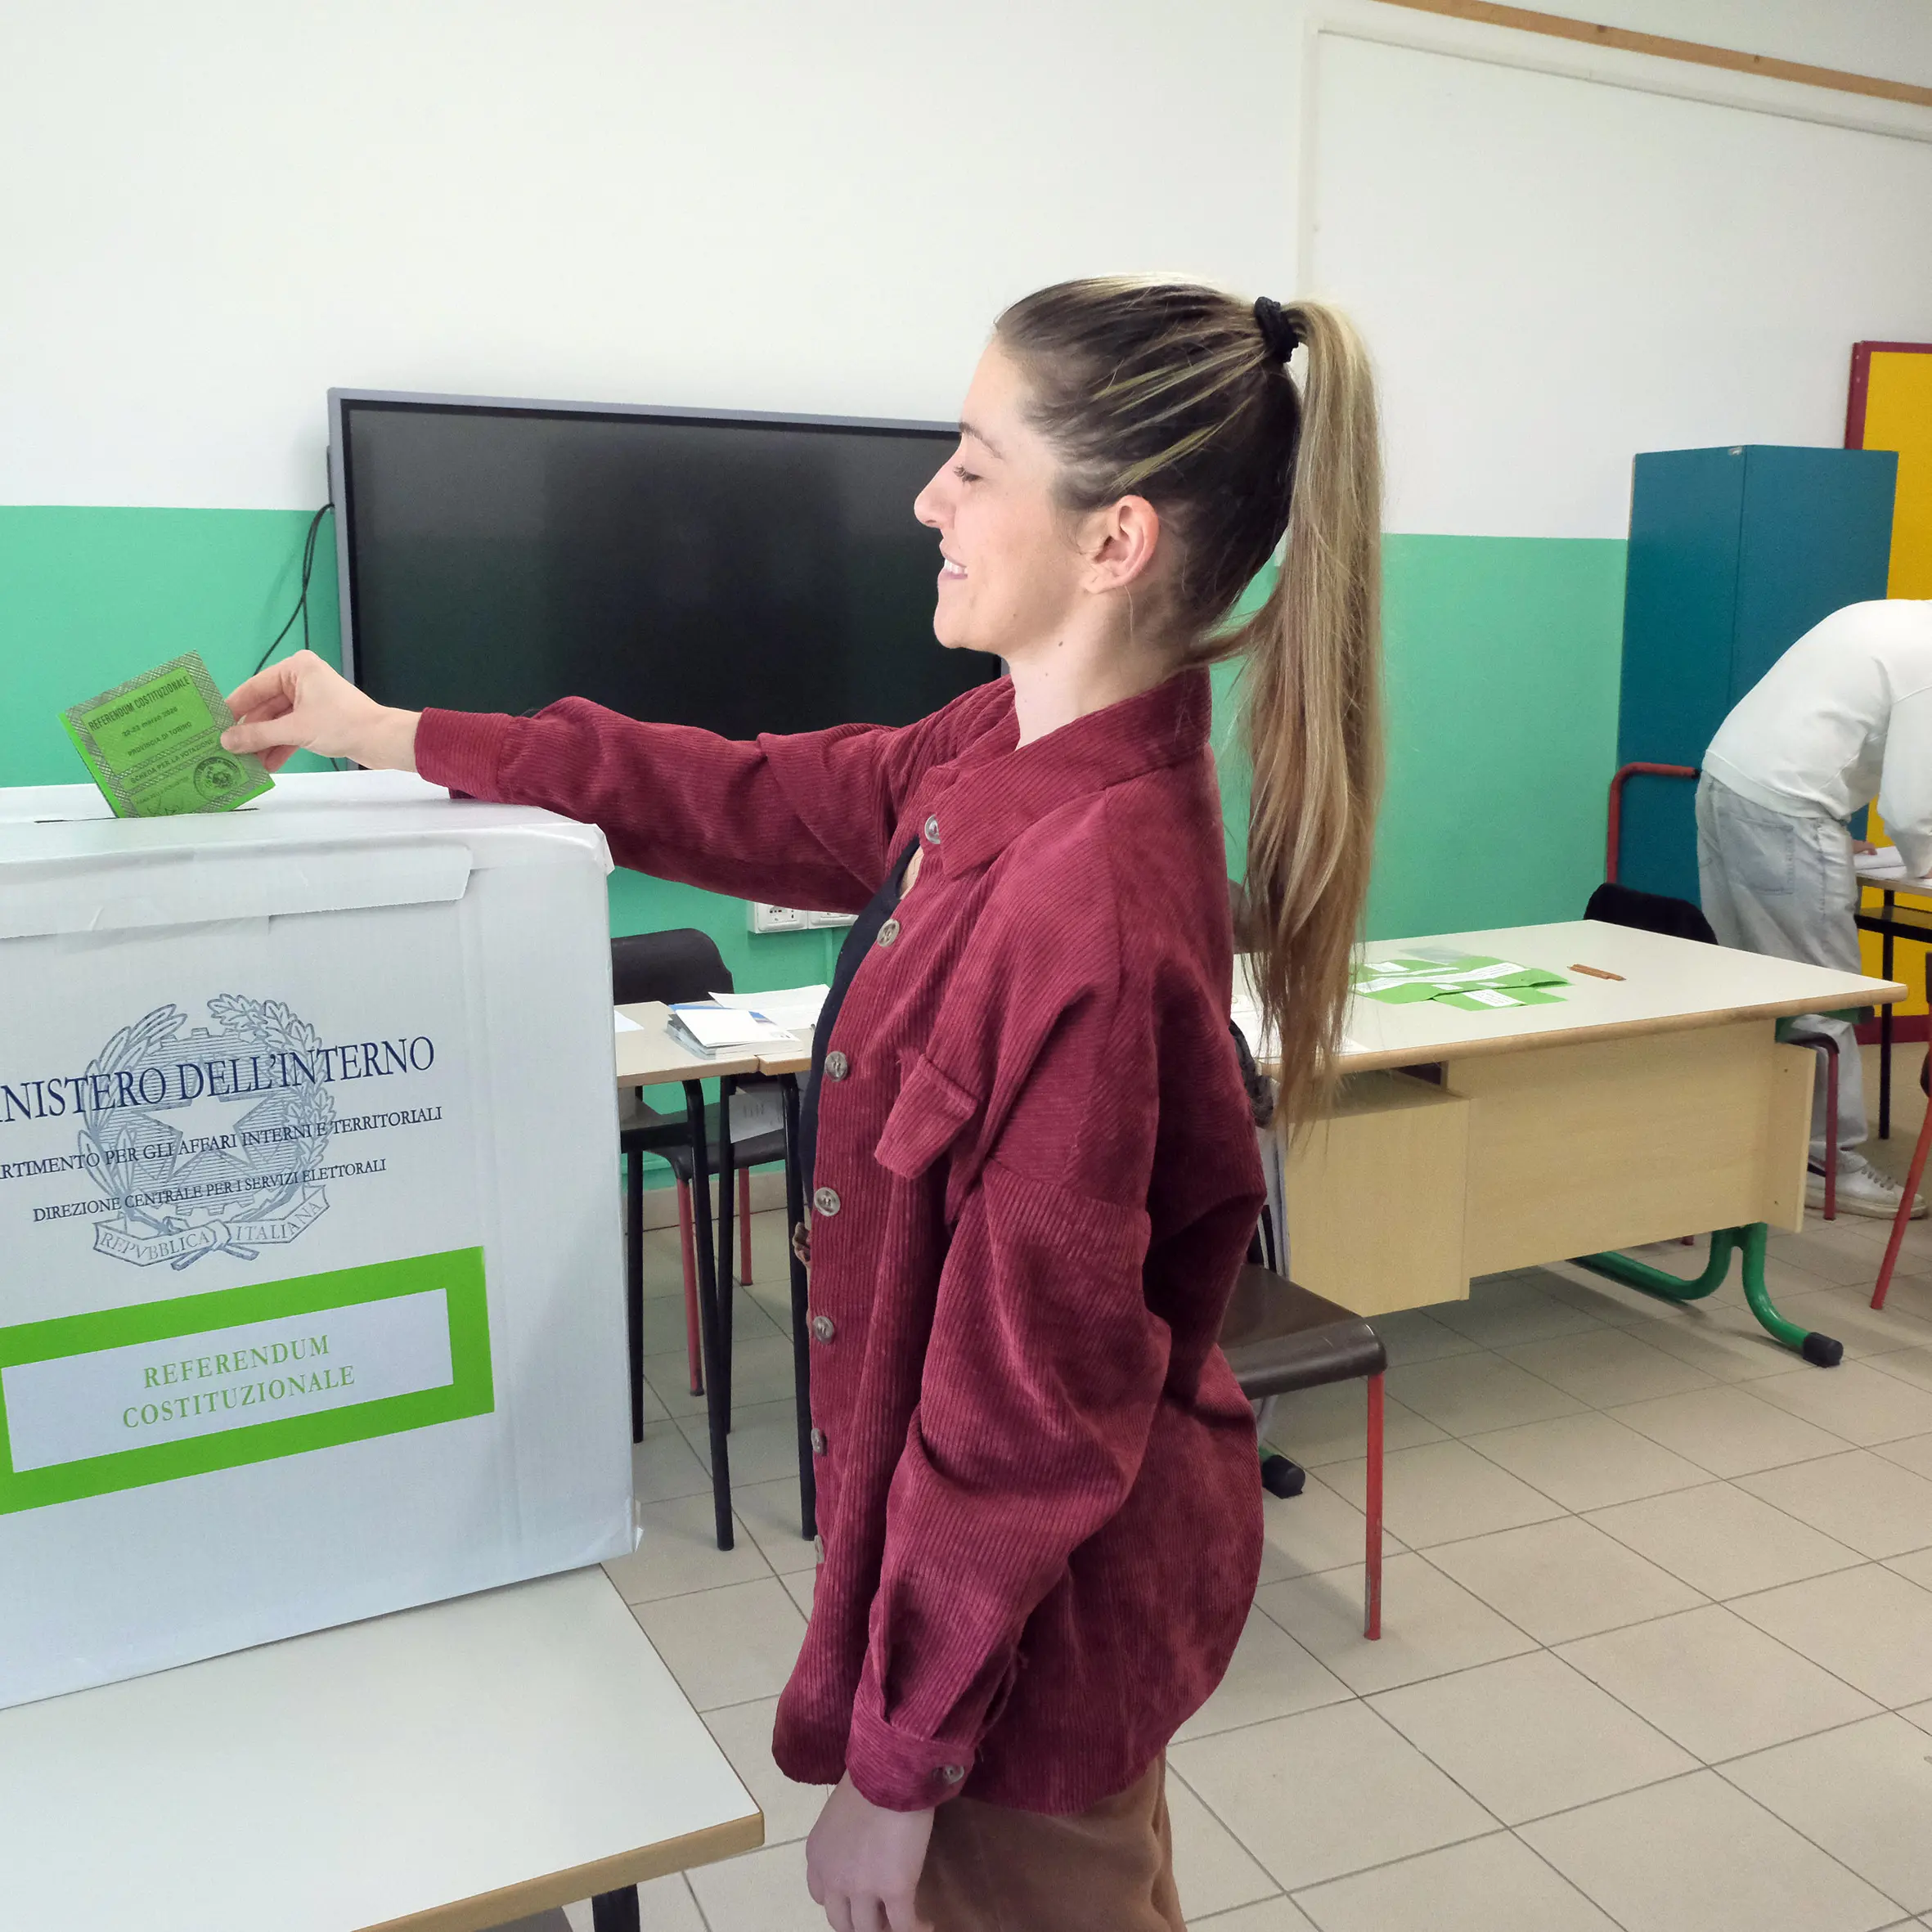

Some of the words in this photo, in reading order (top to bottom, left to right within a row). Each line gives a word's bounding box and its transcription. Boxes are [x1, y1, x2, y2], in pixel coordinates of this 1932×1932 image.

[88, 703, 135, 731] REFERENDUM
[134, 676, 191, 708] COSTITUZIONALE
[142, 715, 162, 728] marzo
[128, 736, 161, 757] PROVINCIA
[161, 733, 169, 741] DI
[168, 721, 192, 736] TORINO
[131, 767, 156, 783] SCHEDA
[157, 760, 171, 770] PER
[171, 755, 179, 763] LA
[180, 739, 213, 757] VOTAZIONE
[0, 1067, 167, 1122] NISTERO
[176, 1036, 435, 1100] DELL'INTERNO
[0, 1152, 100, 1179] RTIMENTO
[106, 1148, 138, 1165] PER
[143, 1142, 174, 1160] GLI
[175, 1134, 236, 1156] AFFARI
[242, 1124, 312, 1147] INTERNI
[317, 1122, 328, 1137] E
[330, 1106, 443, 1134] TERRITORIALI
[33, 1197, 122, 1222] DIREZIONE
[124, 1186, 203, 1209] CENTRALE
[206, 1180, 235, 1196] PER
[236, 1179, 242, 1193] I
[245, 1171, 299, 1191] SERVIZI
[303, 1158, 387, 1183] ELETTORALI
[100, 1230, 210, 1260] REPVBBLICA
[236, 1202, 322, 1242] ITALIANA
[144, 1334, 330, 1389] REFERENDUM
[123, 1365, 355, 1428] COSTITUZIONALE
